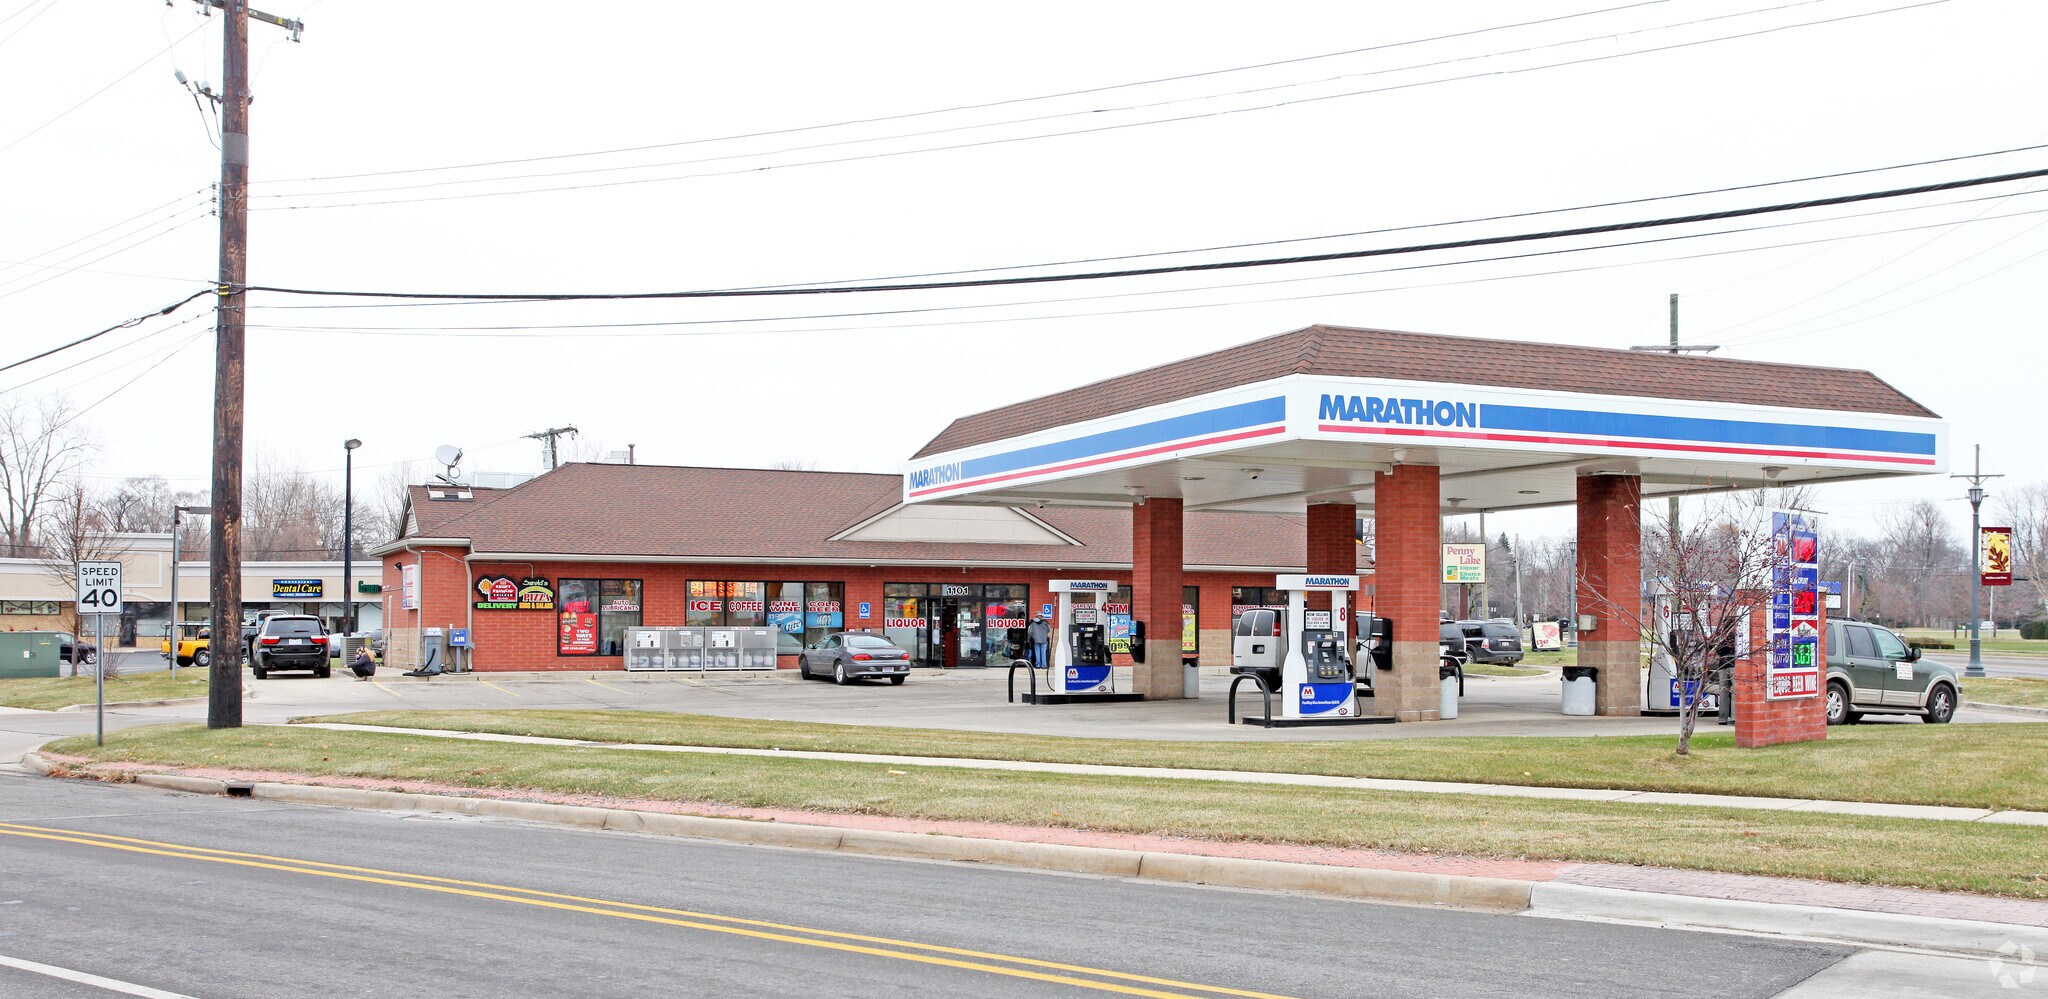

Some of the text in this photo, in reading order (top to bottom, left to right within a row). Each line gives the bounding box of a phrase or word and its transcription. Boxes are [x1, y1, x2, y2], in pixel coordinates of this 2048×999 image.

[1318, 393, 1477, 428] MARATHON
[909, 461, 960, 490] MARATHON
[1447, 546, 1475, 557] Penny
[1460, 556, 1481, 565] Lake
[81, 567, 118, 576] SPEED
[85, 578, 114, 586] LIMIT
[1305, 577, 1350, 585] MARATHON
[273, 584, 322, 593] Dental Care
[358, 580, 379, 593] Green
[947, 586, 969, 595] 1101
[81, 589, 118, 607] 40
[523, 593, 551, 602] PIZZA
[690, 601, 722, 611] ICE
[729, 601, 763, 612] COFFEE
[1101, 602, 1108, 614] 4
[1340, 607, 1346, 621] 8
[1663, 605, 1669, 618] 6
[886, 618, 926, 628] LIQUOR
[988, 619, 1026, 628] LIQUOR
[1773, 653, 1789, 663] LOTTO
[1792, 675, 1804, 692] BEER
[1805, 674, 1817, 691] WINE
